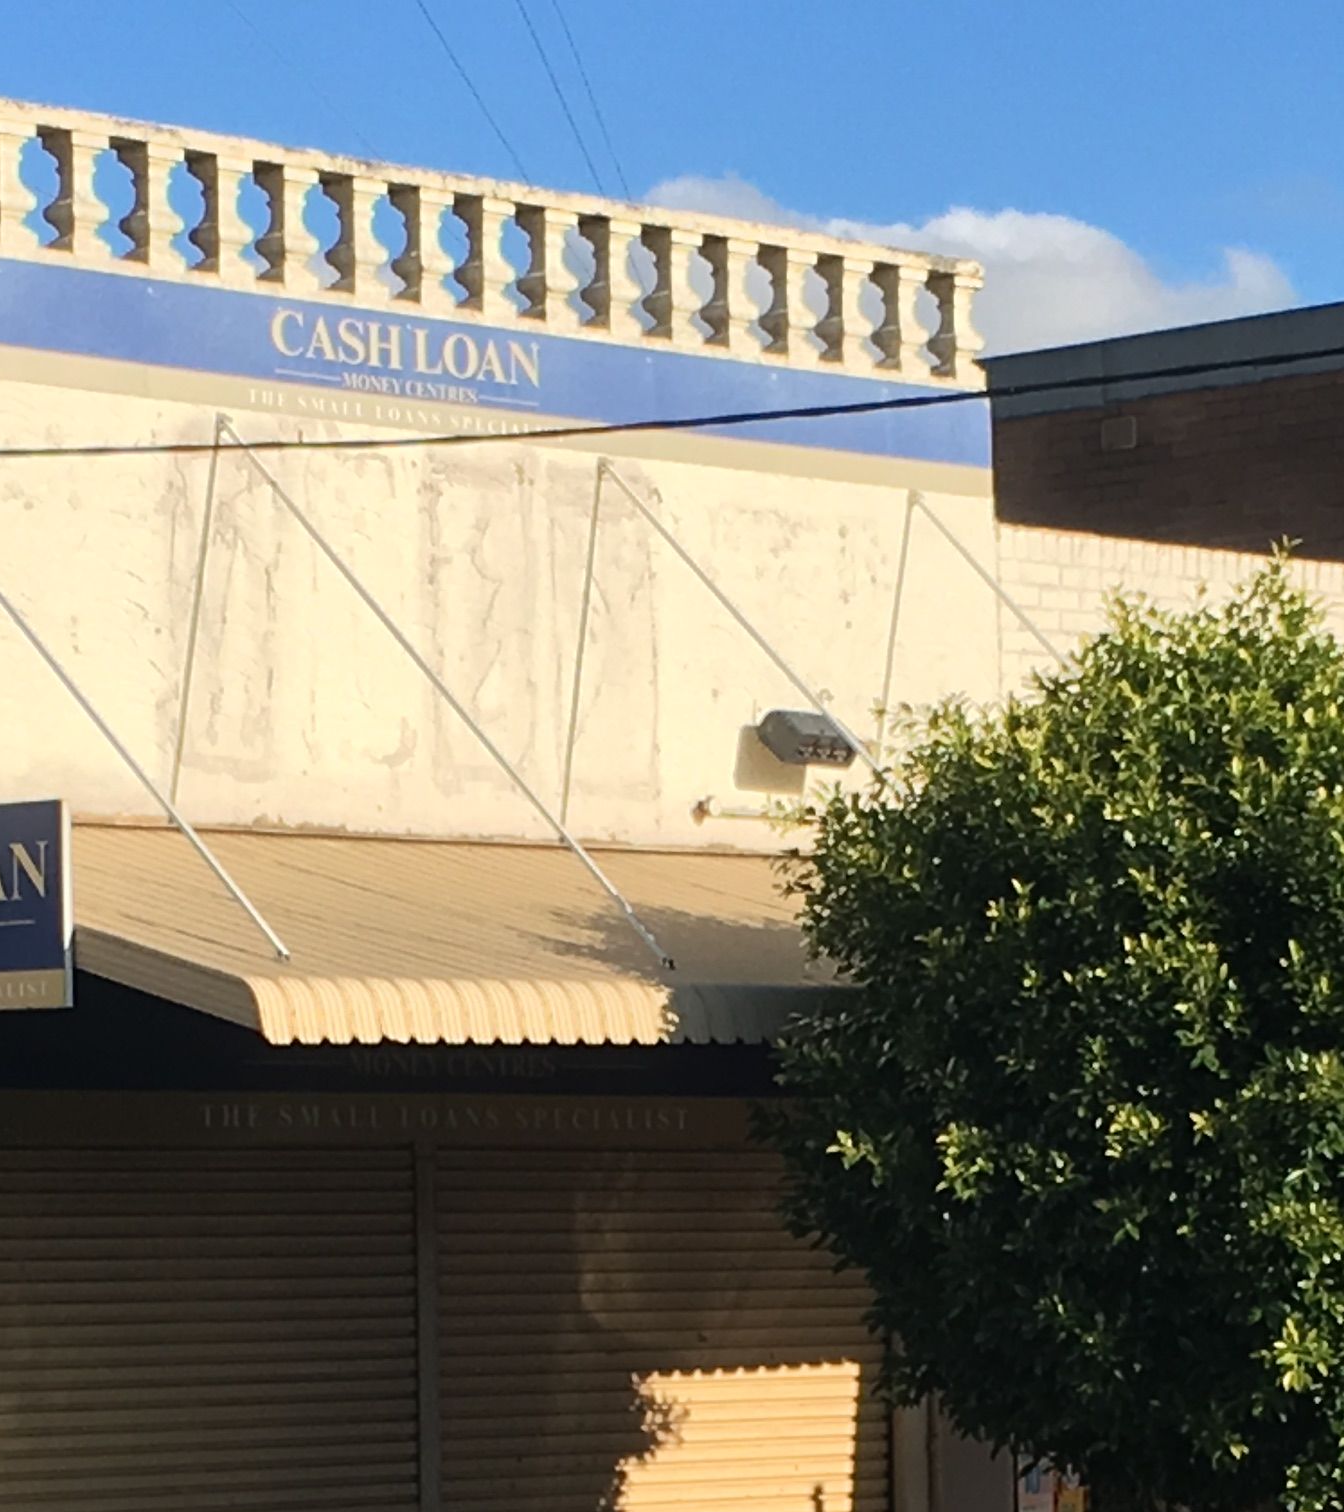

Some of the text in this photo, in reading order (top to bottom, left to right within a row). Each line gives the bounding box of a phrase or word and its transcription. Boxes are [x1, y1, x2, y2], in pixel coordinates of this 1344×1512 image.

[270, 308, 542, 389] CASH LOAN
[341, 371, 479, 404] MONEY CENTRES
[247, 388, 285, 408] THE
[297, 395, 366, 418] SMALL
[375, 402, 442, 426] LOANS
[202, 1105, 690, 1132] THE SMALL LOANS SPECIALIST
